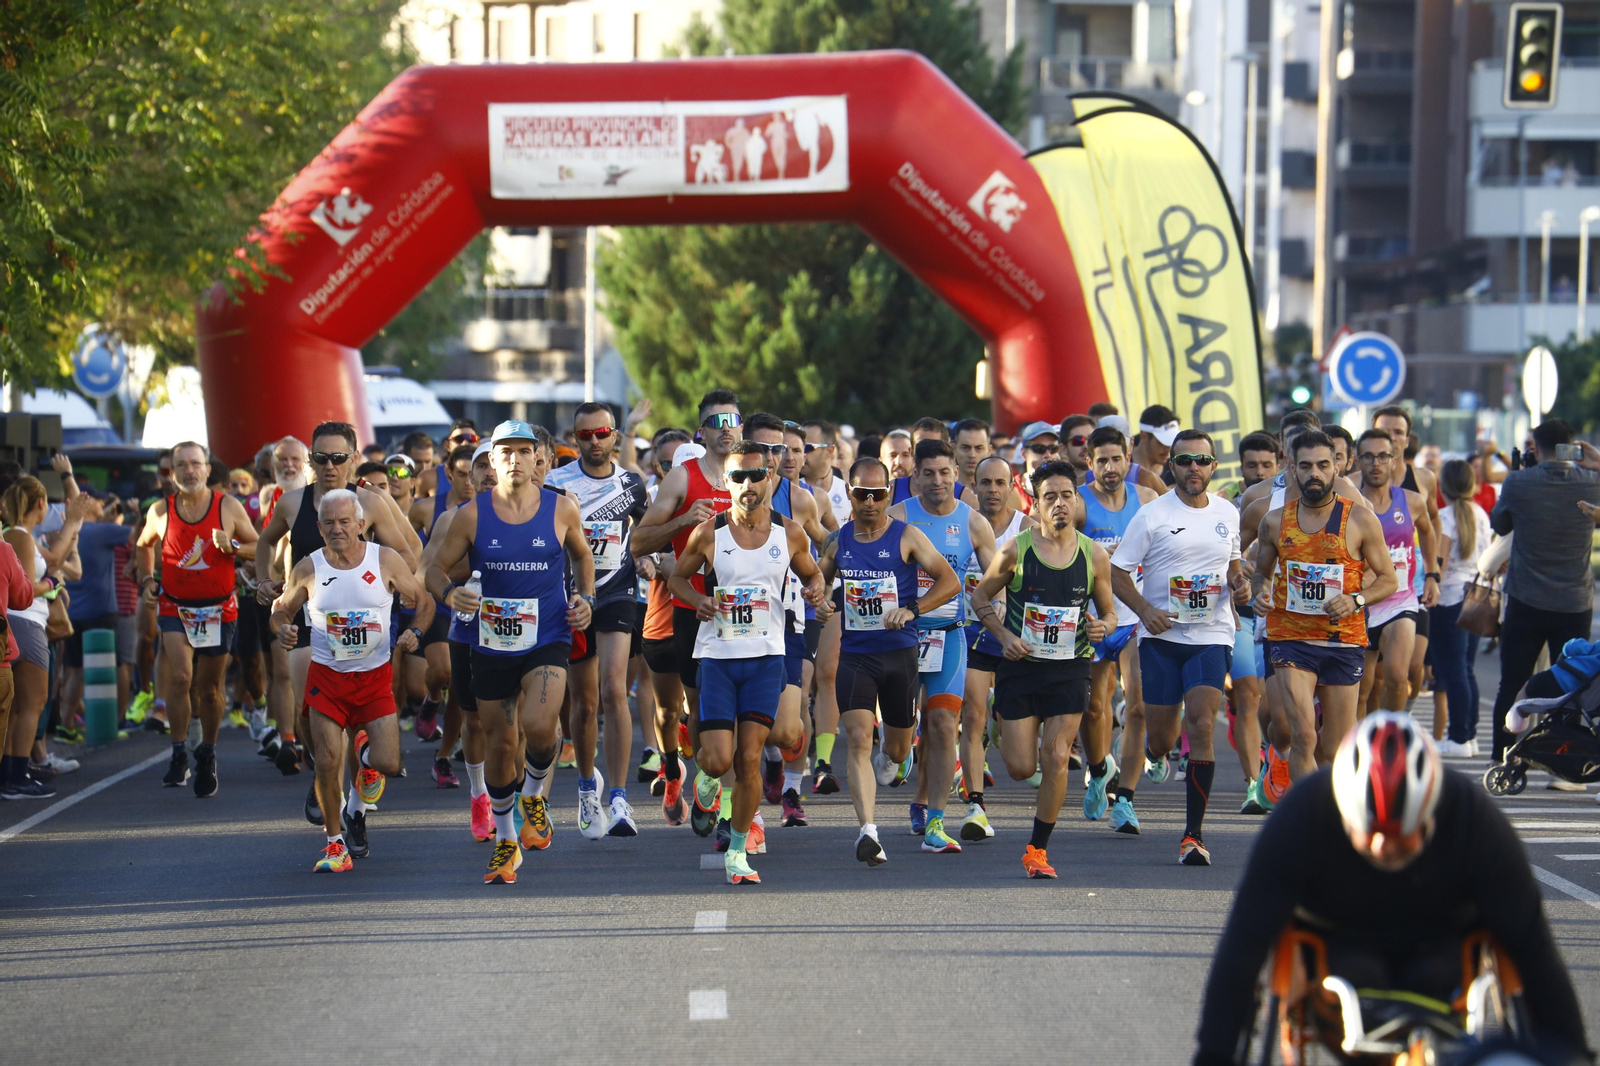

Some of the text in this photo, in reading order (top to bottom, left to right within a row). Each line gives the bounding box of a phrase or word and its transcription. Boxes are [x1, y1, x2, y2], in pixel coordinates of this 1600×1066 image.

[504, 115, 678, 131] CIRCUITO PROVINCIAL DE
[504, 130, 678, 147] CARRERAS POPULARES
[898, 161, 1045, 302] Diputación de Córdoba
[299, 171, 445, 315] Diputación de Córdoba
[606, 494, 626, 510] SUBIDA
[612, 494, 635, 515] VELETA
[485, 562, 549, 571] TROTASIERRA
[840, 569, 896, 578] TROTASIERRA
[1189, 590, 1208, 609] 95
[1300, 581, 1326, 601] 130
[730, 605, 753, 625] 113
[857, 597, 883, 617] 318
[341, 627, 368, 646] 391
[493, 618, 523, 637] 395
[1043, 625, 1059, 645] 18
